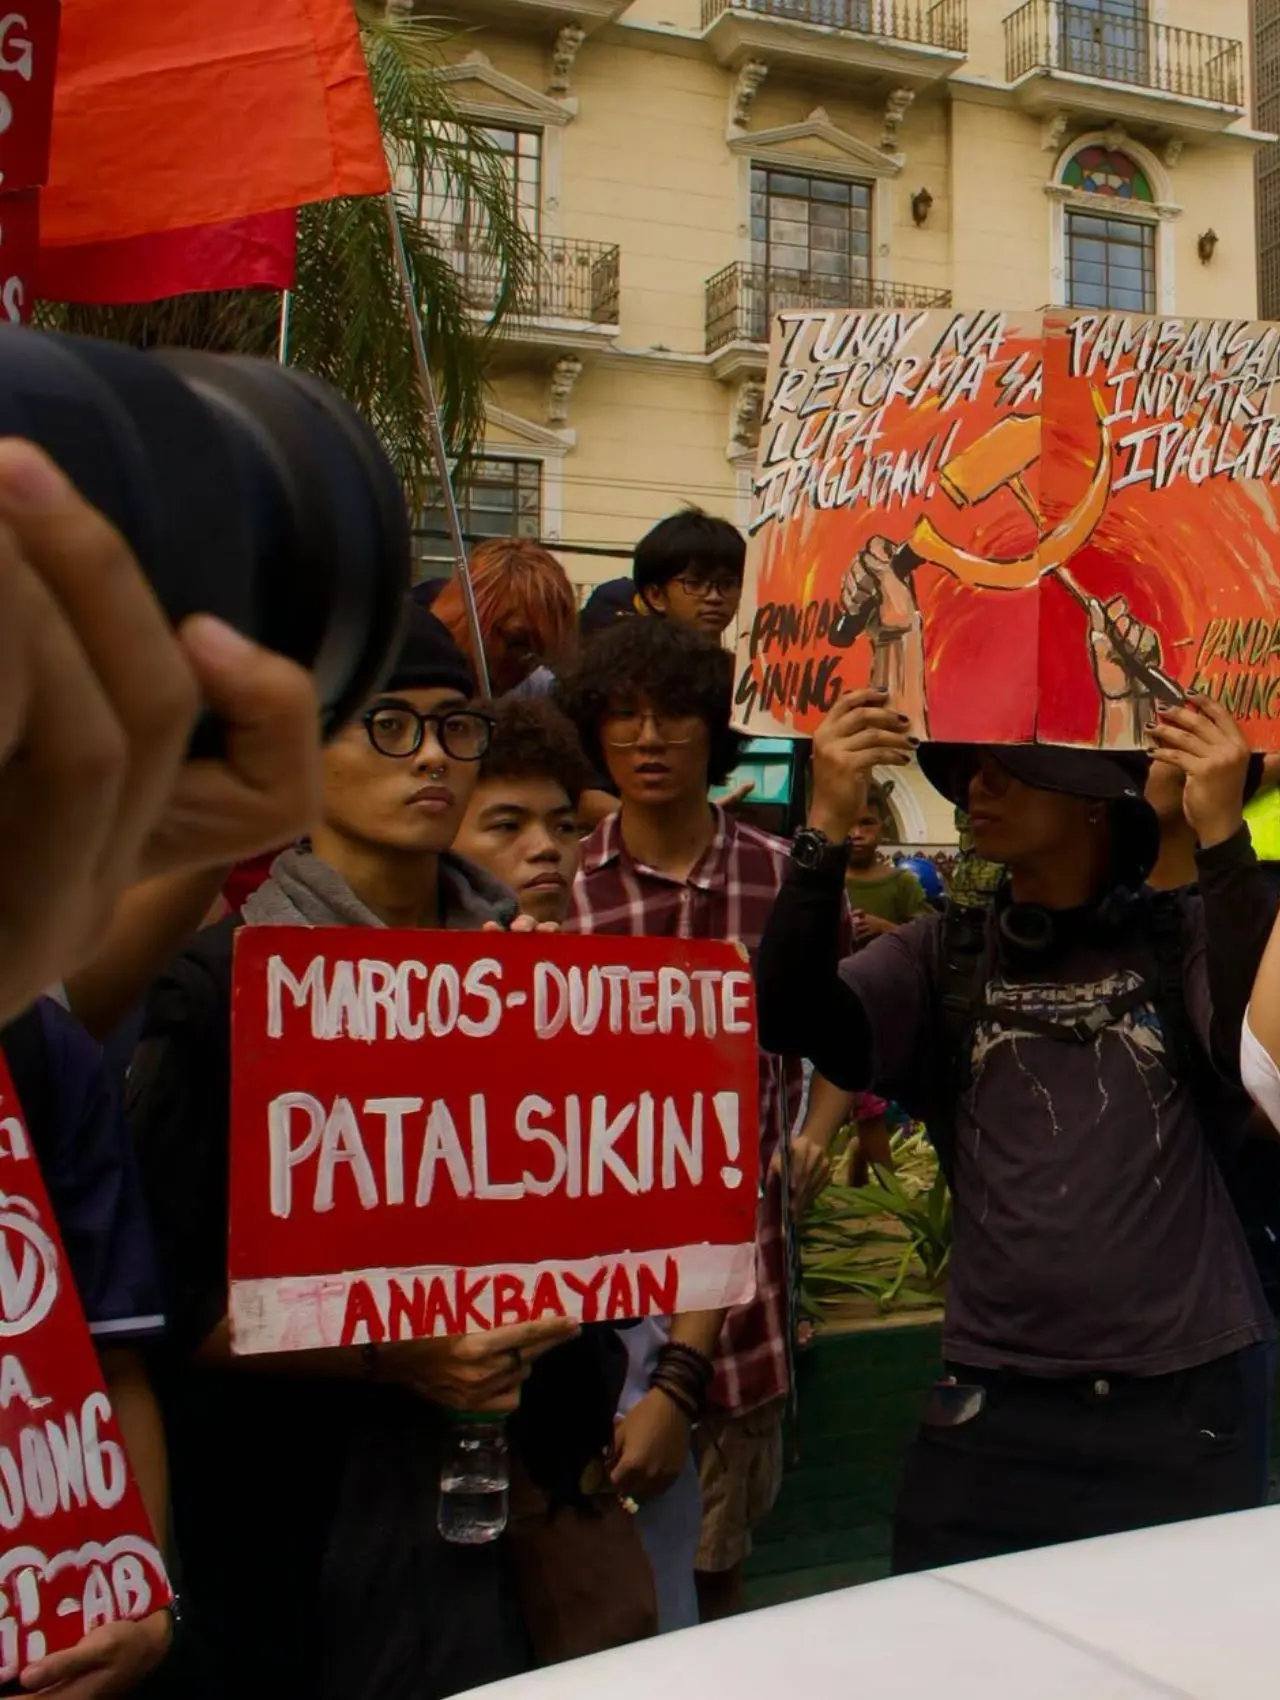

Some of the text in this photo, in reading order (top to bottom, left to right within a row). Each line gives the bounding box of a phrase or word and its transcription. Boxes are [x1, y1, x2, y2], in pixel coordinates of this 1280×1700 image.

[777, 310, 1006, 368] TUNAY NA
[995, 351, 1043, 407] SA
[762, 402, 886, 468] LUPA
[266, 955, 752, 1044] MARCOS-DUTERTE
[268, 1091, 745, 1219] PATALSIKIN!
[340, 1254, 680, 1347] ANAKBAYAN
